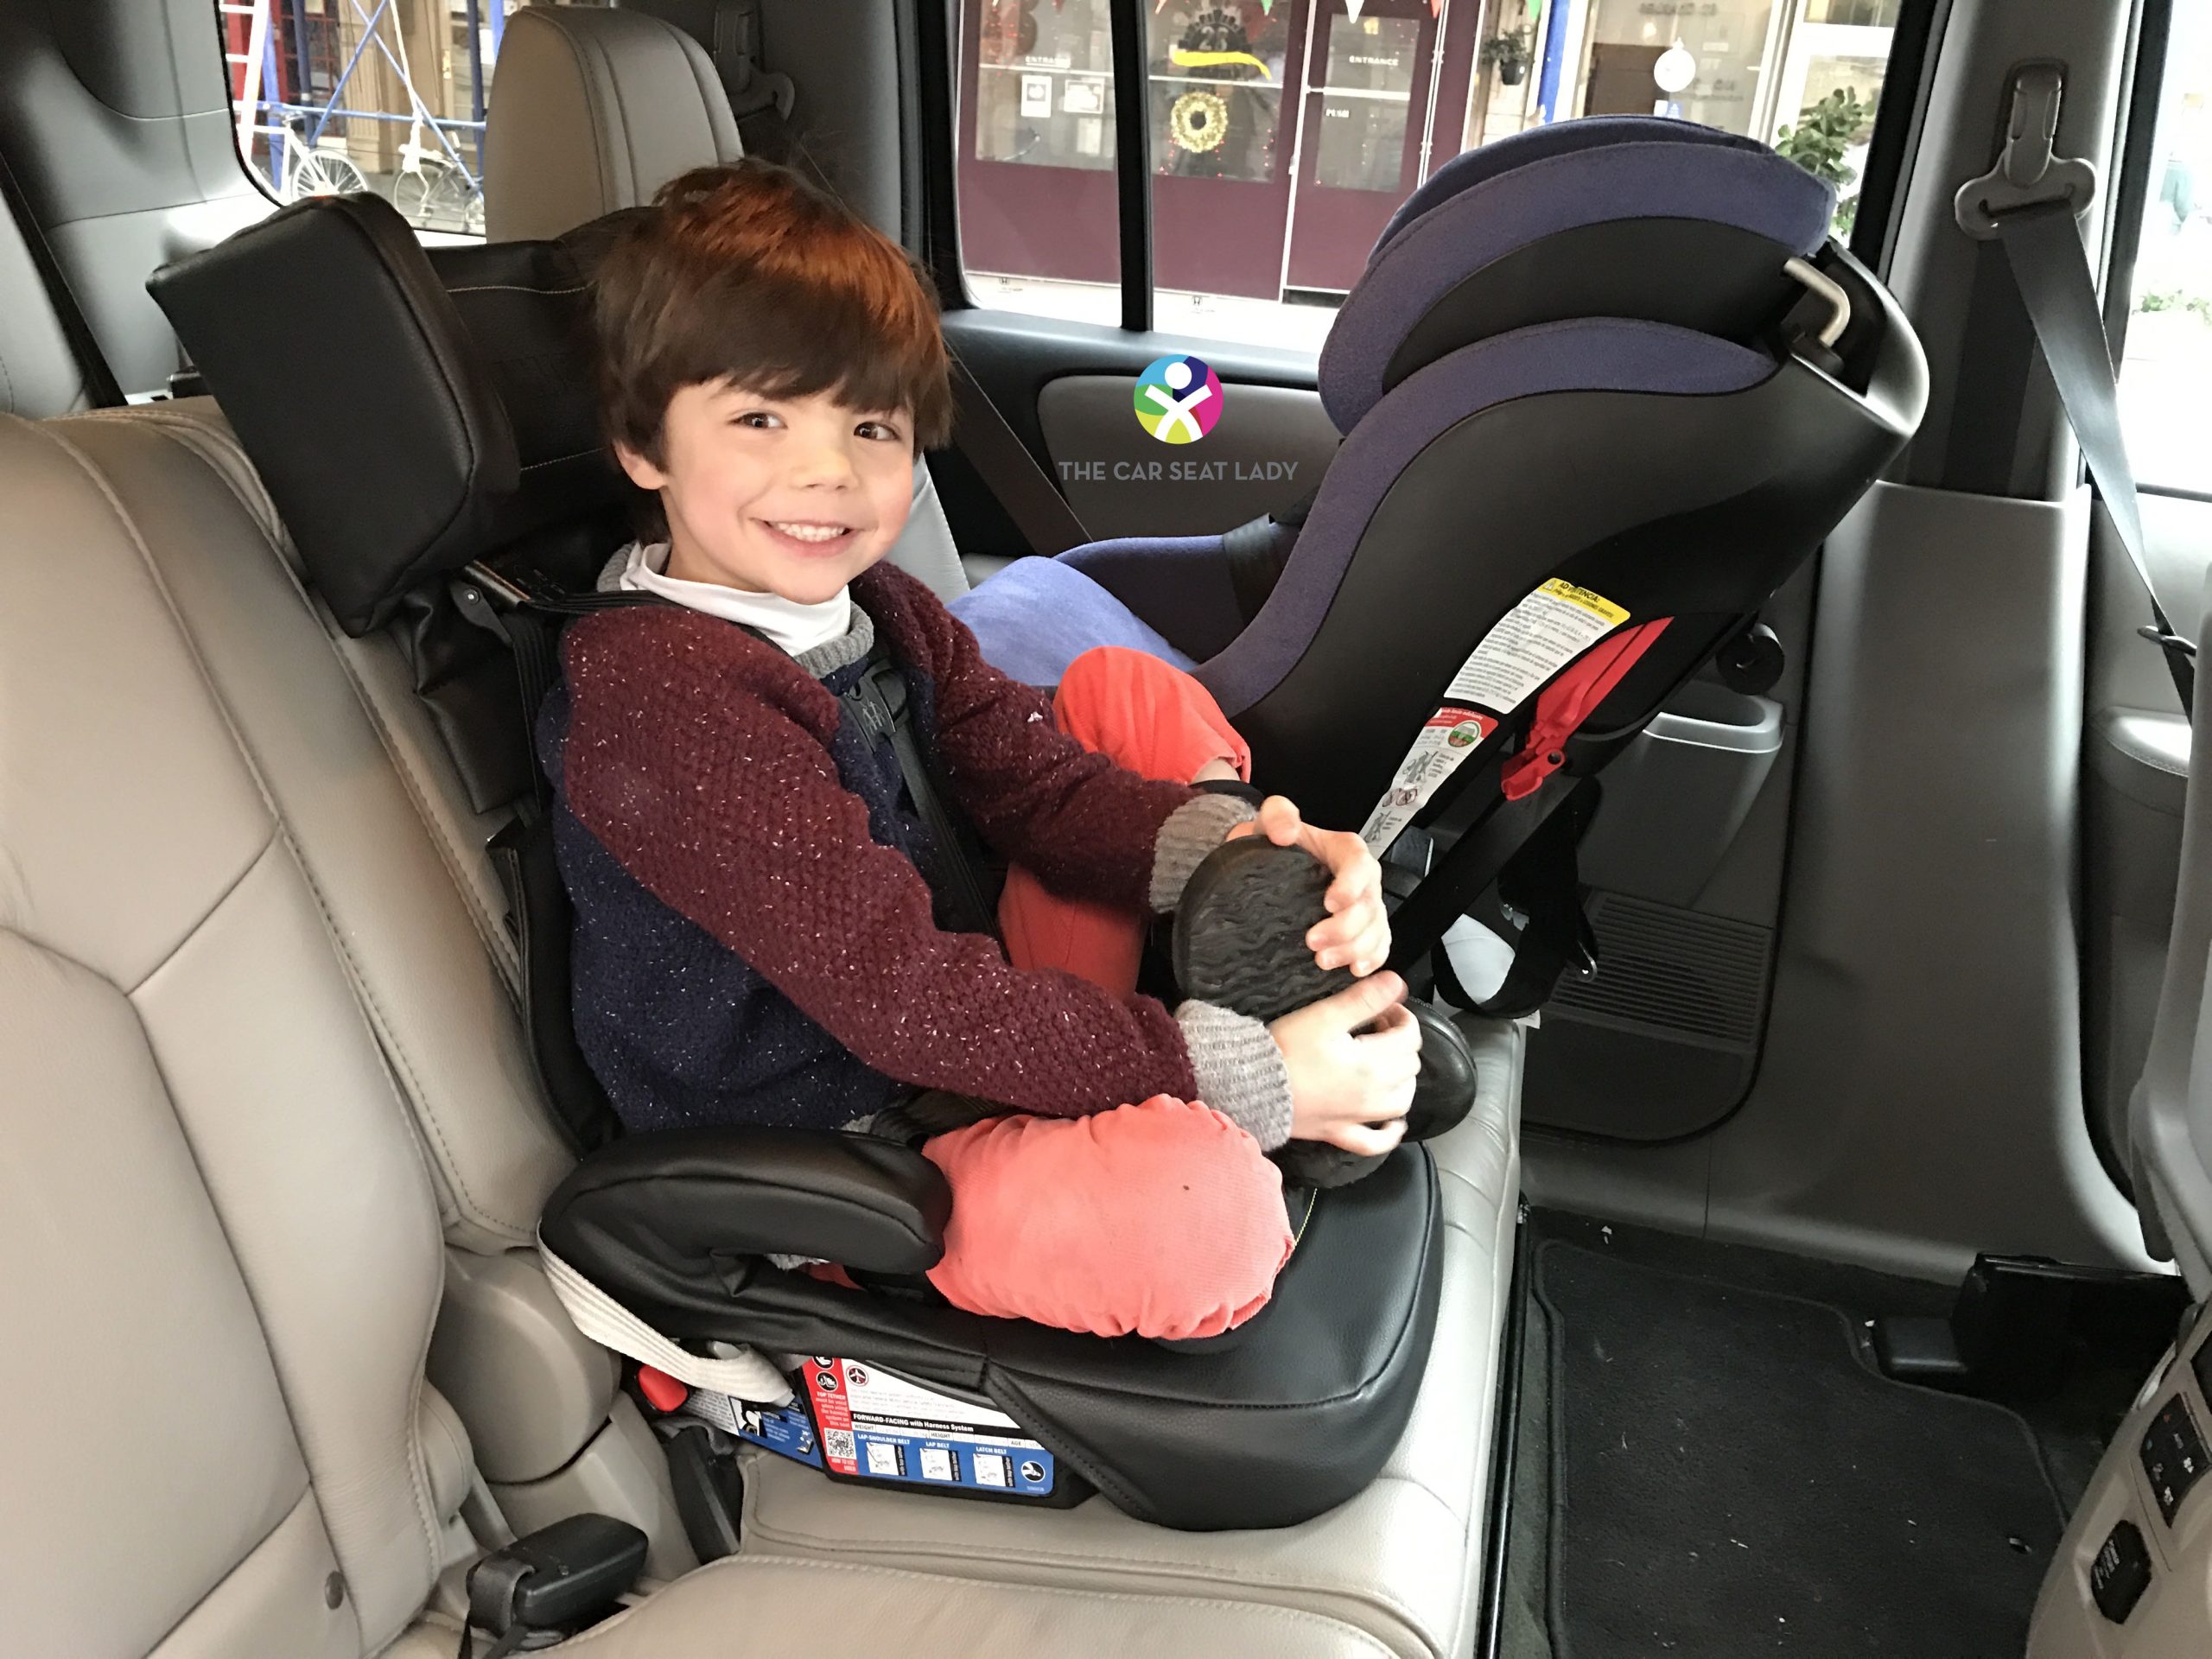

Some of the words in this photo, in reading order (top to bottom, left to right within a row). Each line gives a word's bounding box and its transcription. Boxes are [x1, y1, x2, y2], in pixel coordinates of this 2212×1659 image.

[1349, 55, 1399, 67] ENTRANCE
[853, 1413, 909, 1426] FORWARD-FACING
[924, 1421, 950, 1430] Harness
[950, 1424, 974, 1433] System
